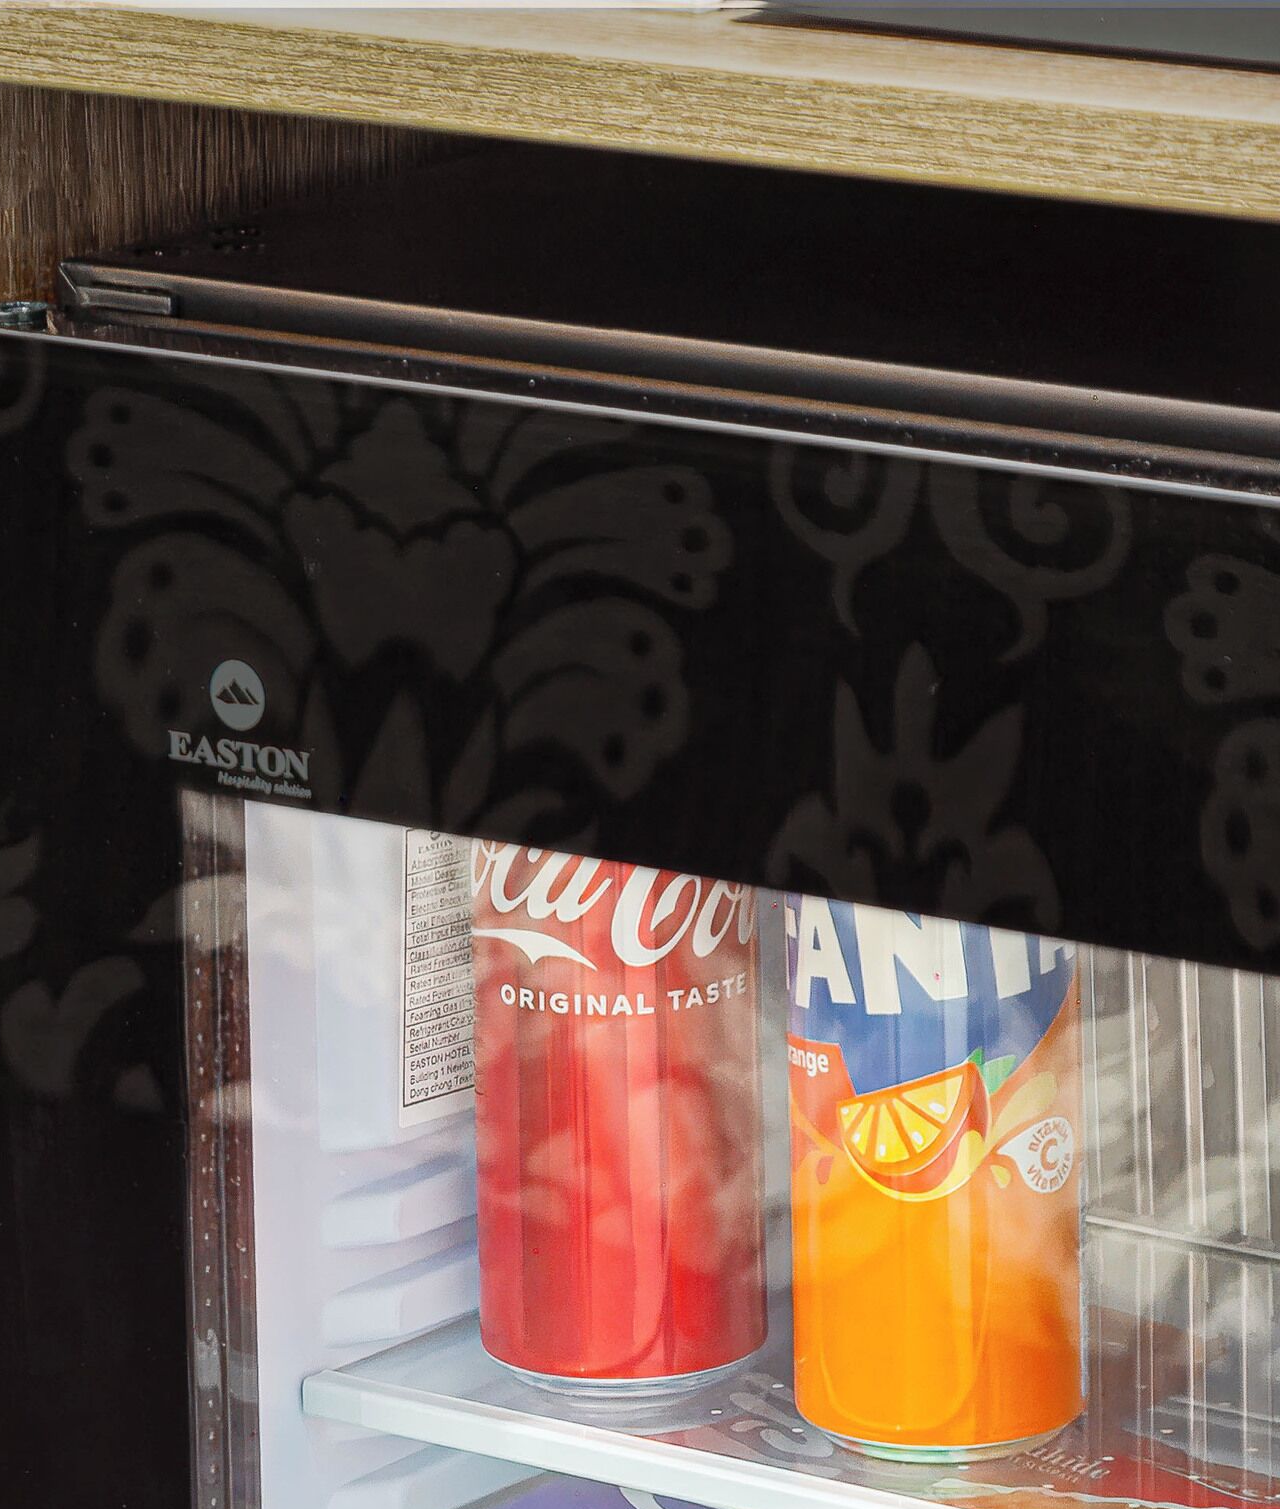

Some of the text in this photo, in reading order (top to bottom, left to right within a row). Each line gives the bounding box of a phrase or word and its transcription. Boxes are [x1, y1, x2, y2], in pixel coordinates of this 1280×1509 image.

[168, 729, 312, 781] EASTON
[500, 973, 747, 1017] ORIGINAL TASTE
[410, 1045, 471, 1072] EASTON HOTEL
[788, 1045, 830, 1077] ange
[1040, 1137, 1058, 1170] C
